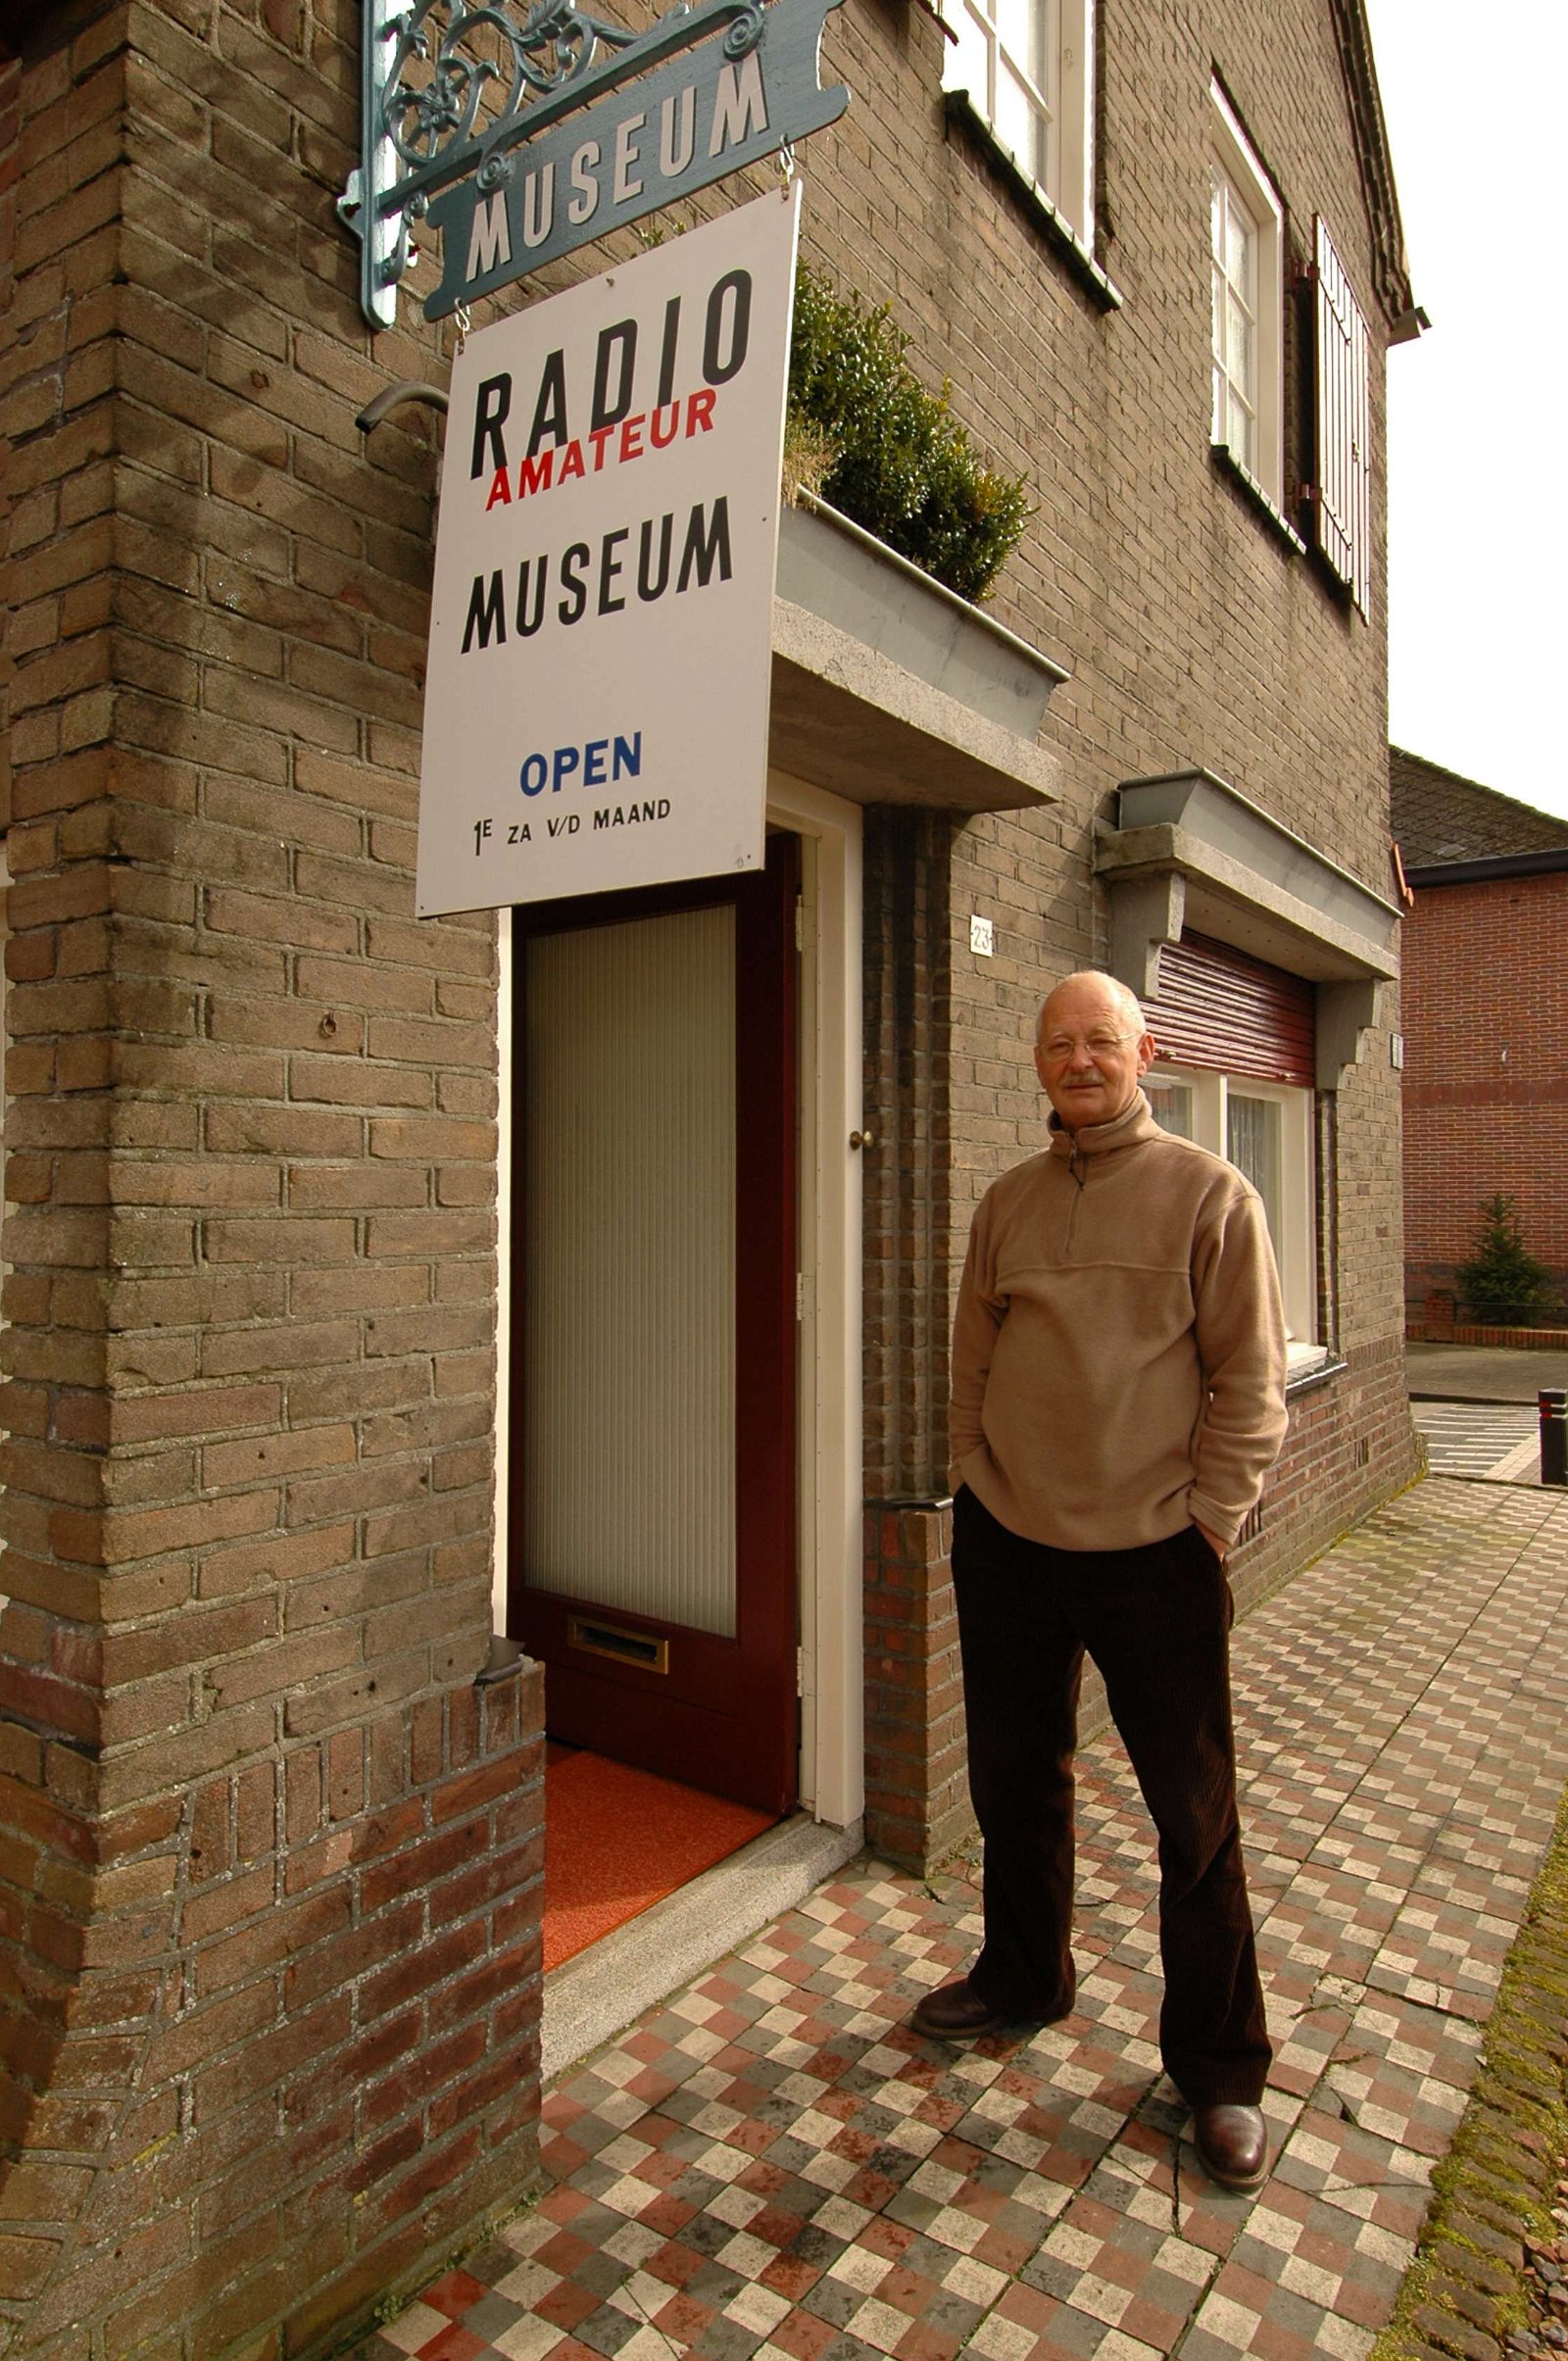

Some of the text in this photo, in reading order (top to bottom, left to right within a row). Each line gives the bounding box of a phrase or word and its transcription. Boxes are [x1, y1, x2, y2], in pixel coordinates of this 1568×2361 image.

[466, 50, 768, 283] MUSEUM
[470, 269, 753, 480] RADIO
[485, 388, 717, 512] AMATEUR
[461, 495, 733, 655] MUSEUM
[508, 824, 532, 845] ZA
[547, 814, 581, 838] V/D
[593, 799, 671, 831] MAAND
[519, 731, 642, 797] OPEN
[974, 924, 990, 950] 23
